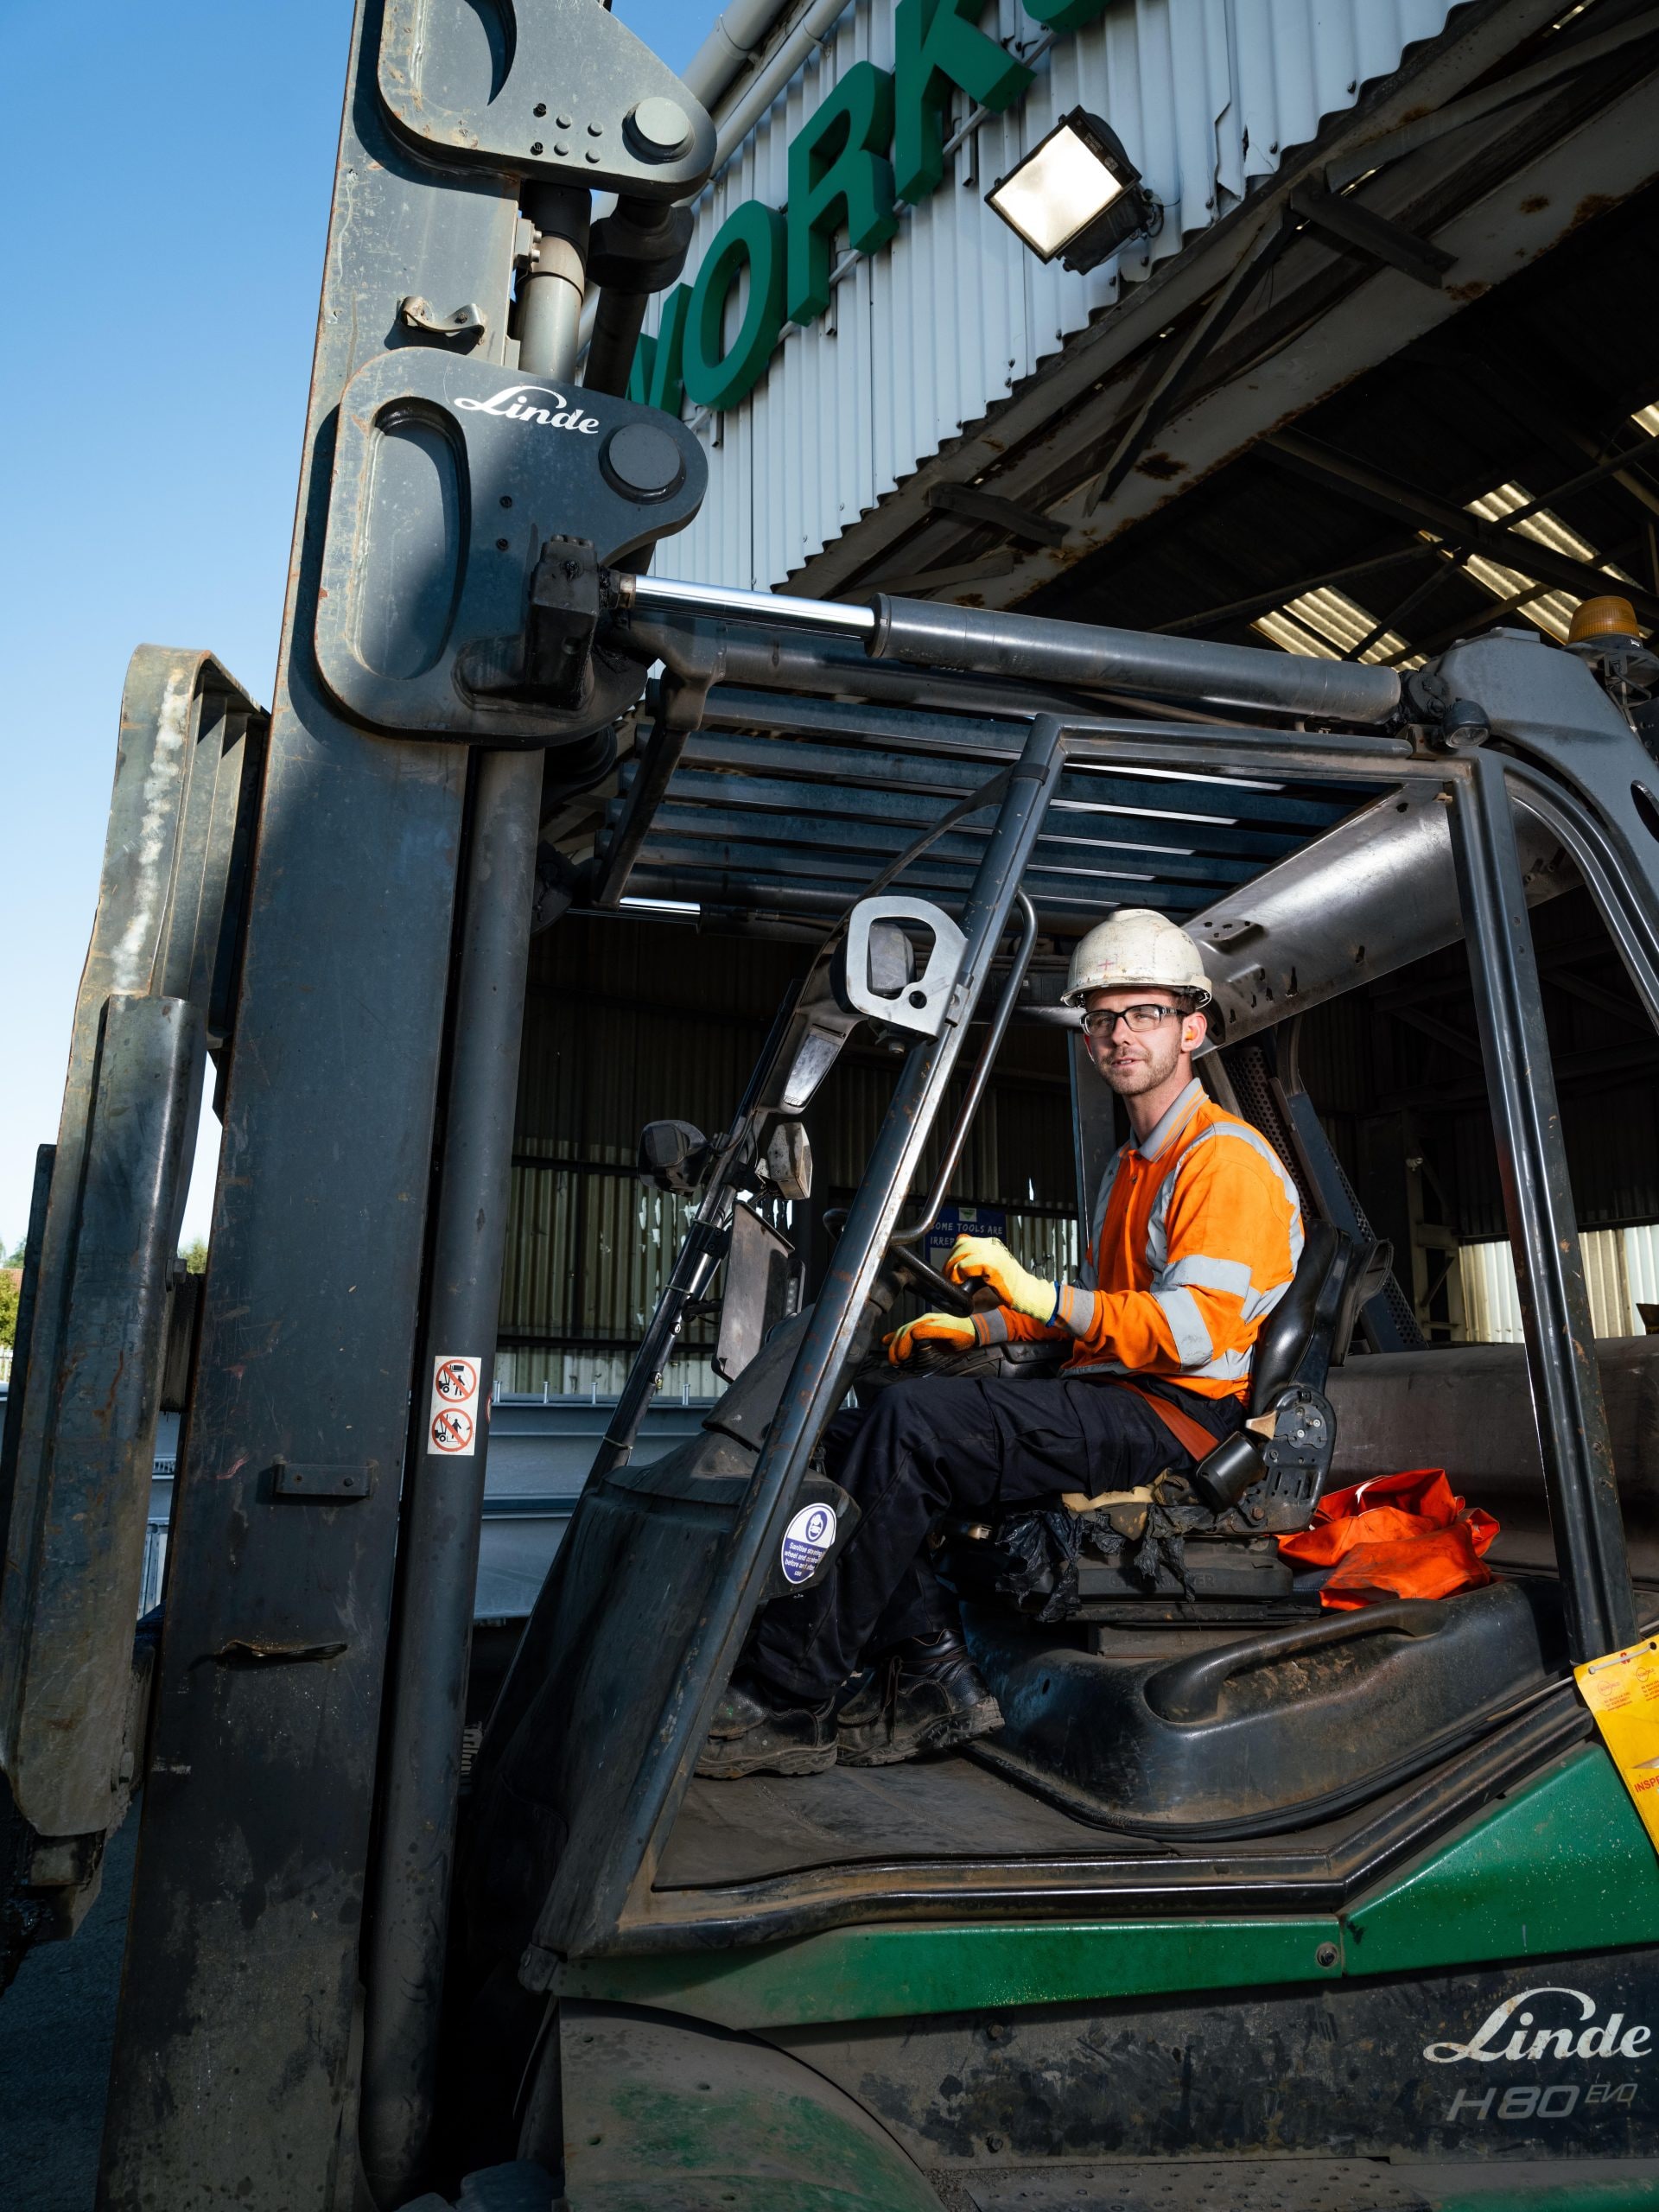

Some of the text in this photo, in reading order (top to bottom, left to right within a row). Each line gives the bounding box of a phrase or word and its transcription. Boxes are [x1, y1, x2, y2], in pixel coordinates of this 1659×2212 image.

[625, 0, 1113, 418] ORK
[454, 385, 600, 435] Linde
[930, 1236, 955, 1246] IRREP
[931, 1222, 1003, 1235] OME TOOLS ARE
[1423, 1986, 1653, 2063] Linde
